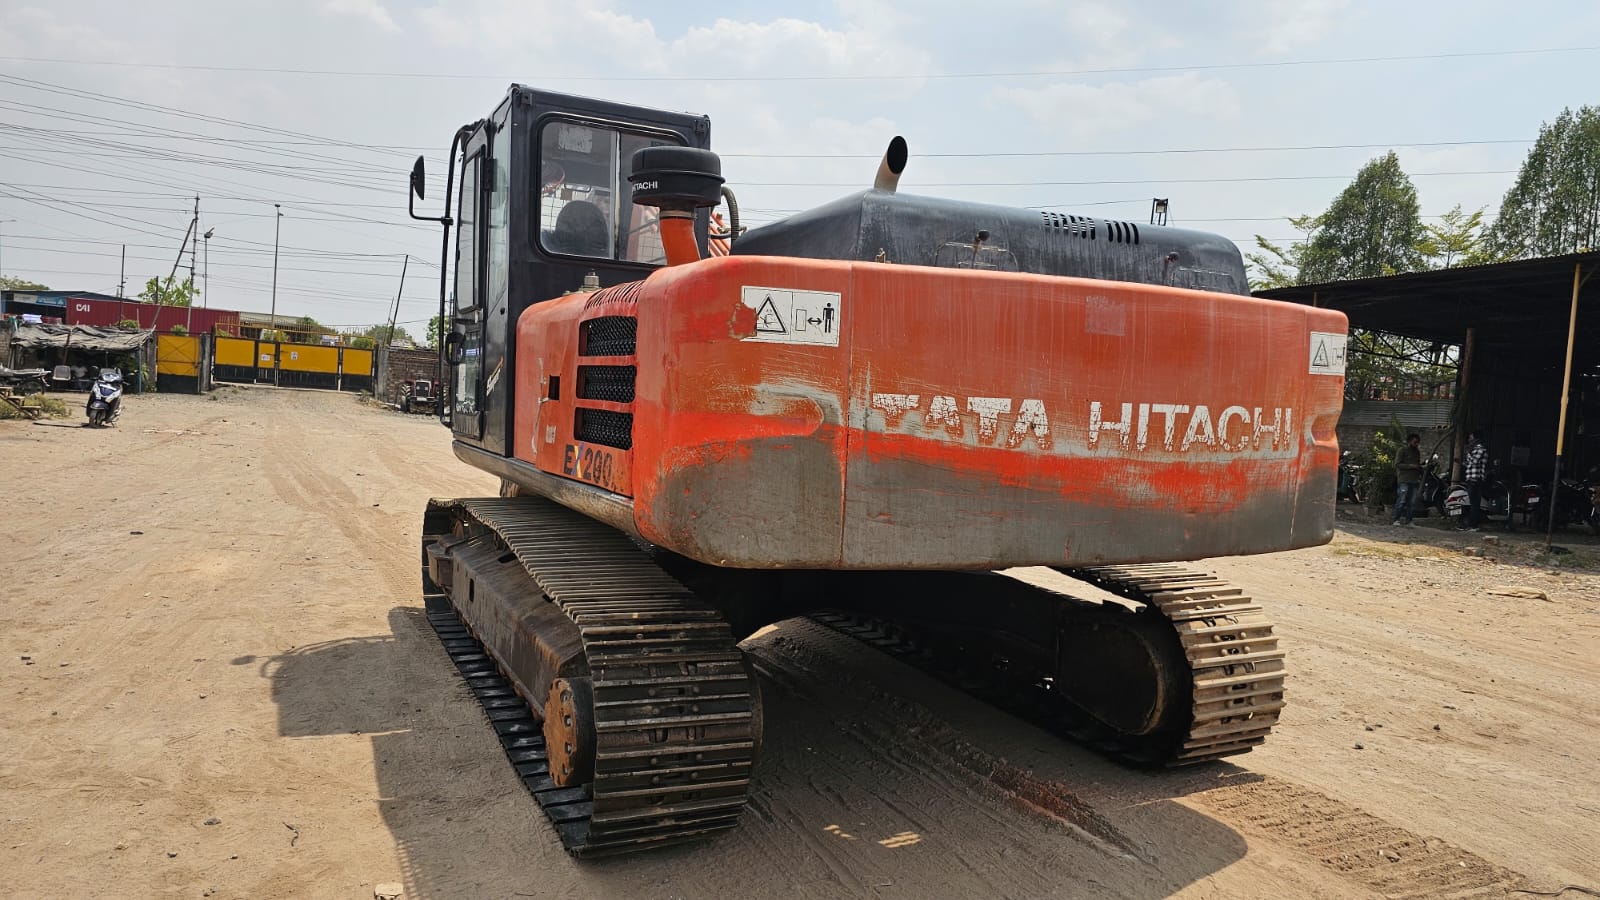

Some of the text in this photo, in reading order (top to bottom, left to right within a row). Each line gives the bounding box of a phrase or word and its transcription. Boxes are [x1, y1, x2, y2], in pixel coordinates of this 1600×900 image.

[76, 304, 91, 312] CAI
[872, 393, 1292, 452] TATA HITACHI
